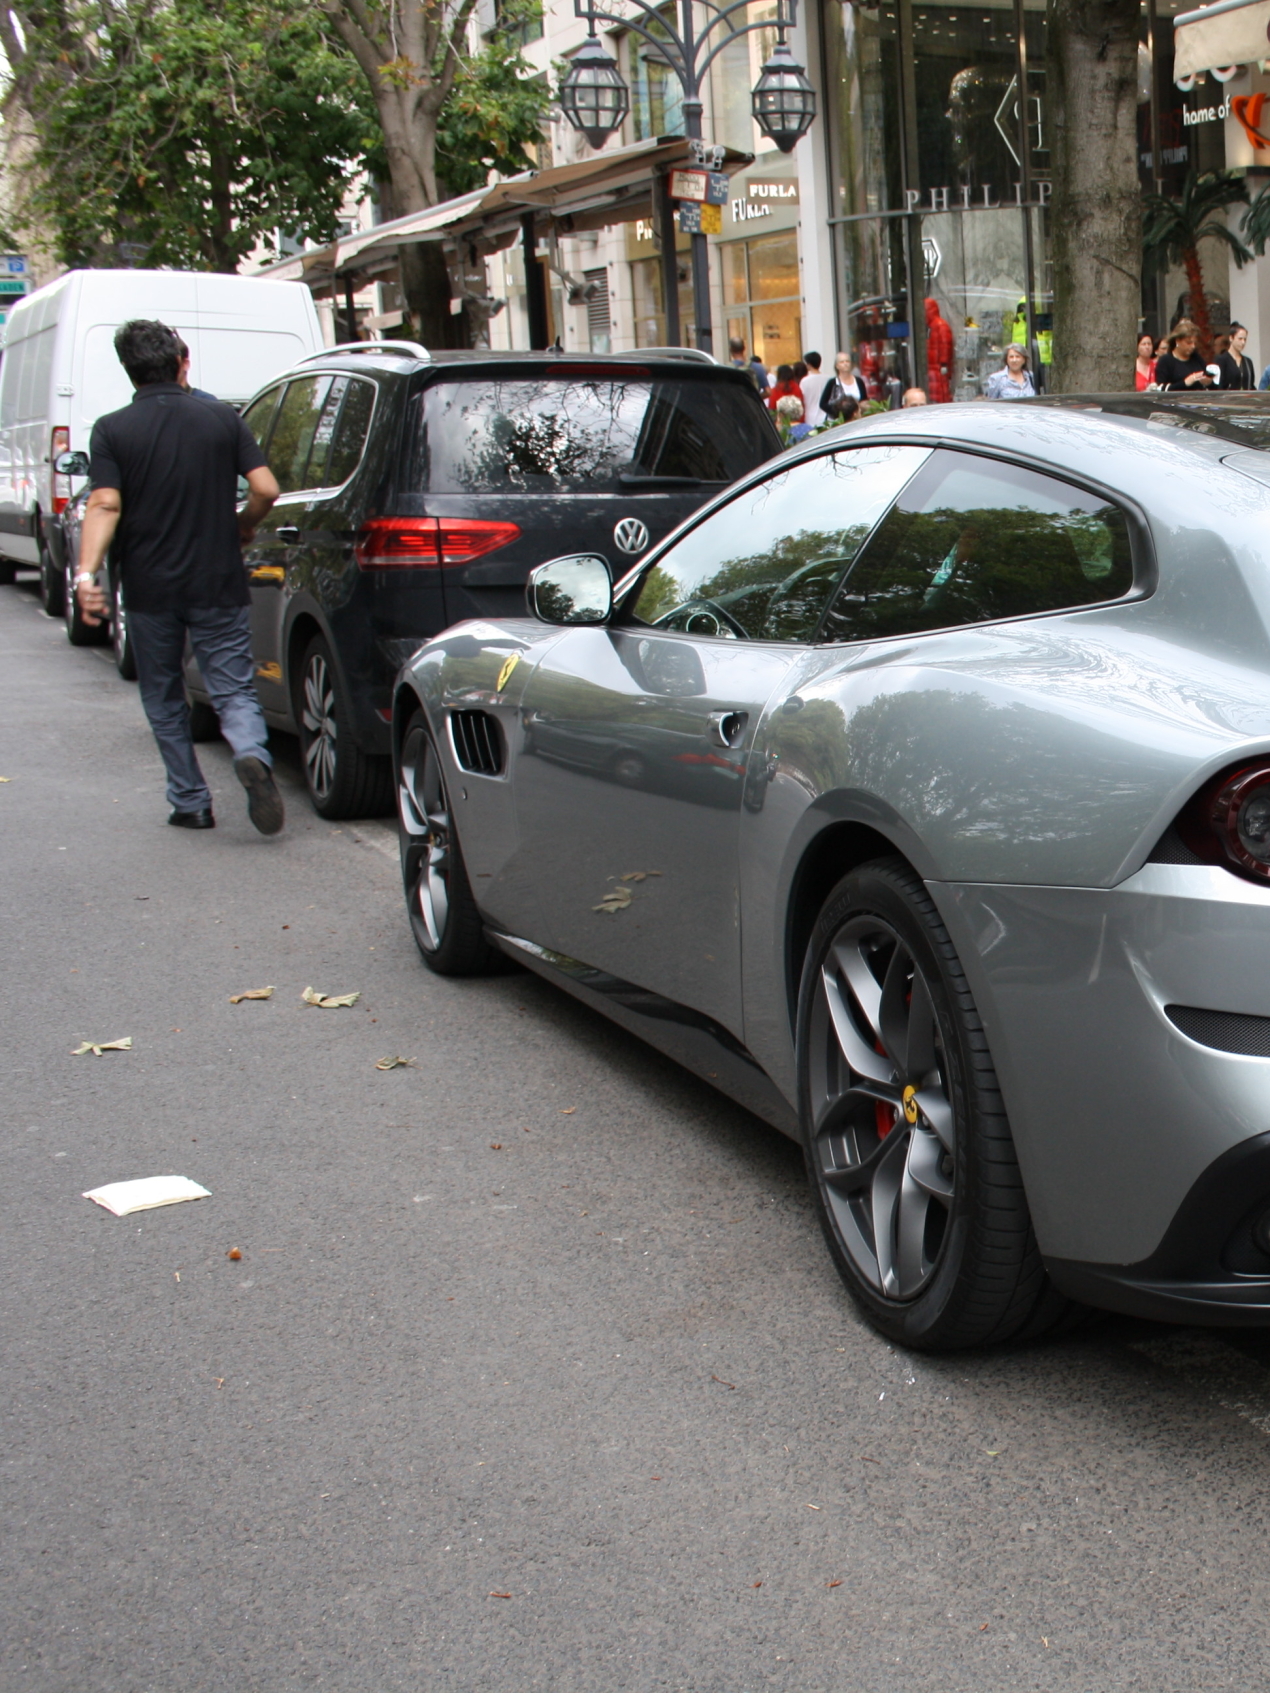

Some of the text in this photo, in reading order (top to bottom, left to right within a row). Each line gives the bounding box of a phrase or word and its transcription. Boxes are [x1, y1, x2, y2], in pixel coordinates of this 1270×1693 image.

[1182, 103, 1217, 126] home
[1218, 94, 1231, 118] of
[750, 184, 797, 198] FURLA
